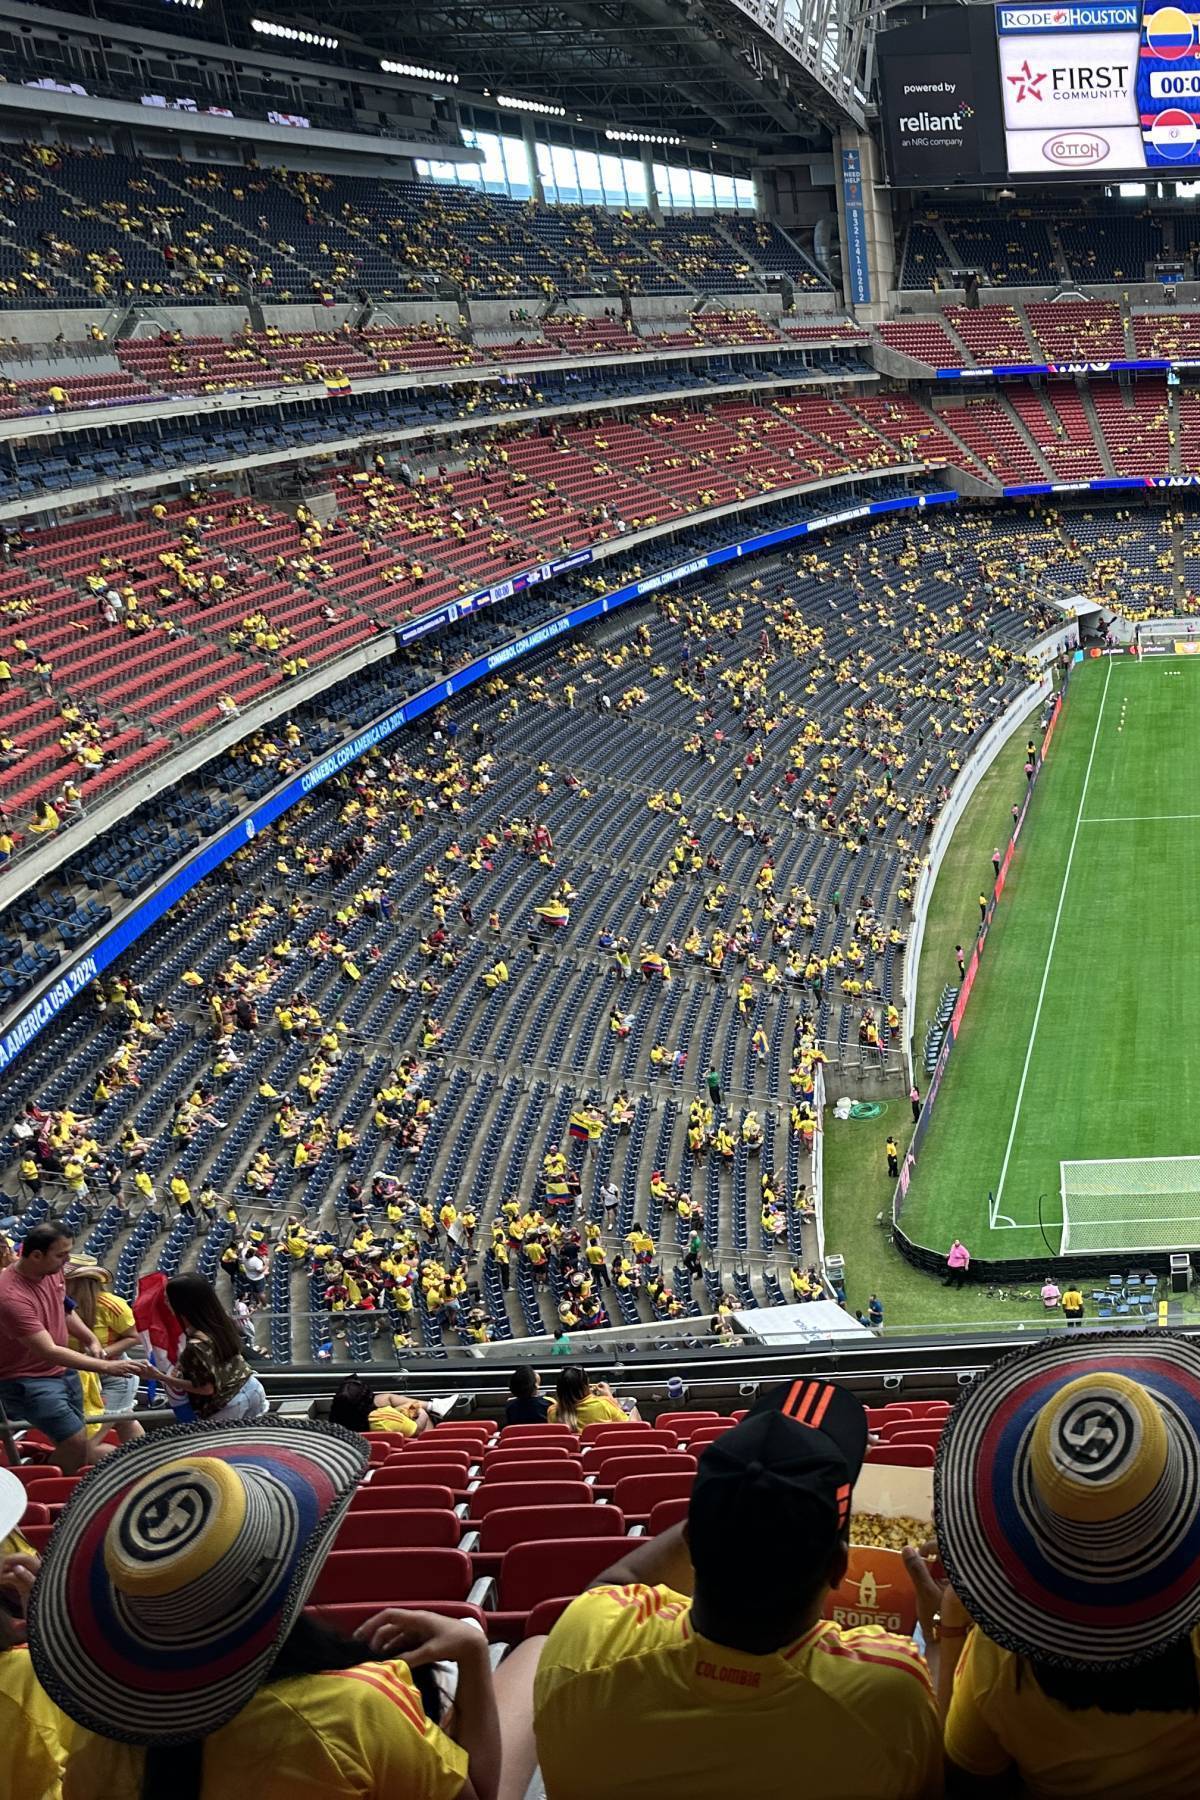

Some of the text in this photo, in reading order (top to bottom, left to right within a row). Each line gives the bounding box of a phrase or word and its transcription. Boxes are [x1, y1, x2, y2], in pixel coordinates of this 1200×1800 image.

[904, 82, 956, 94] powered by
[1052, 66, 1128, 90] FIRST
[1053, 90, 1128, 100] COMMUNITY
[899, 112, 963, 132] reliant
[912, 138, 929, 146] NRG
[930, 138, 963, 146] company
[1051, 141, 1099, 158] COTTON
[302, 756, 338, 791] CONMEBOL
[337, 745, 355, 766] COPA
[354, 727, 381, 760] AMERICA
[380, 719, 391, 737] USA
[8, 955, 97, 1058] AMERICA USA 2024
[833, 1609, 901, 1630] RODEO
